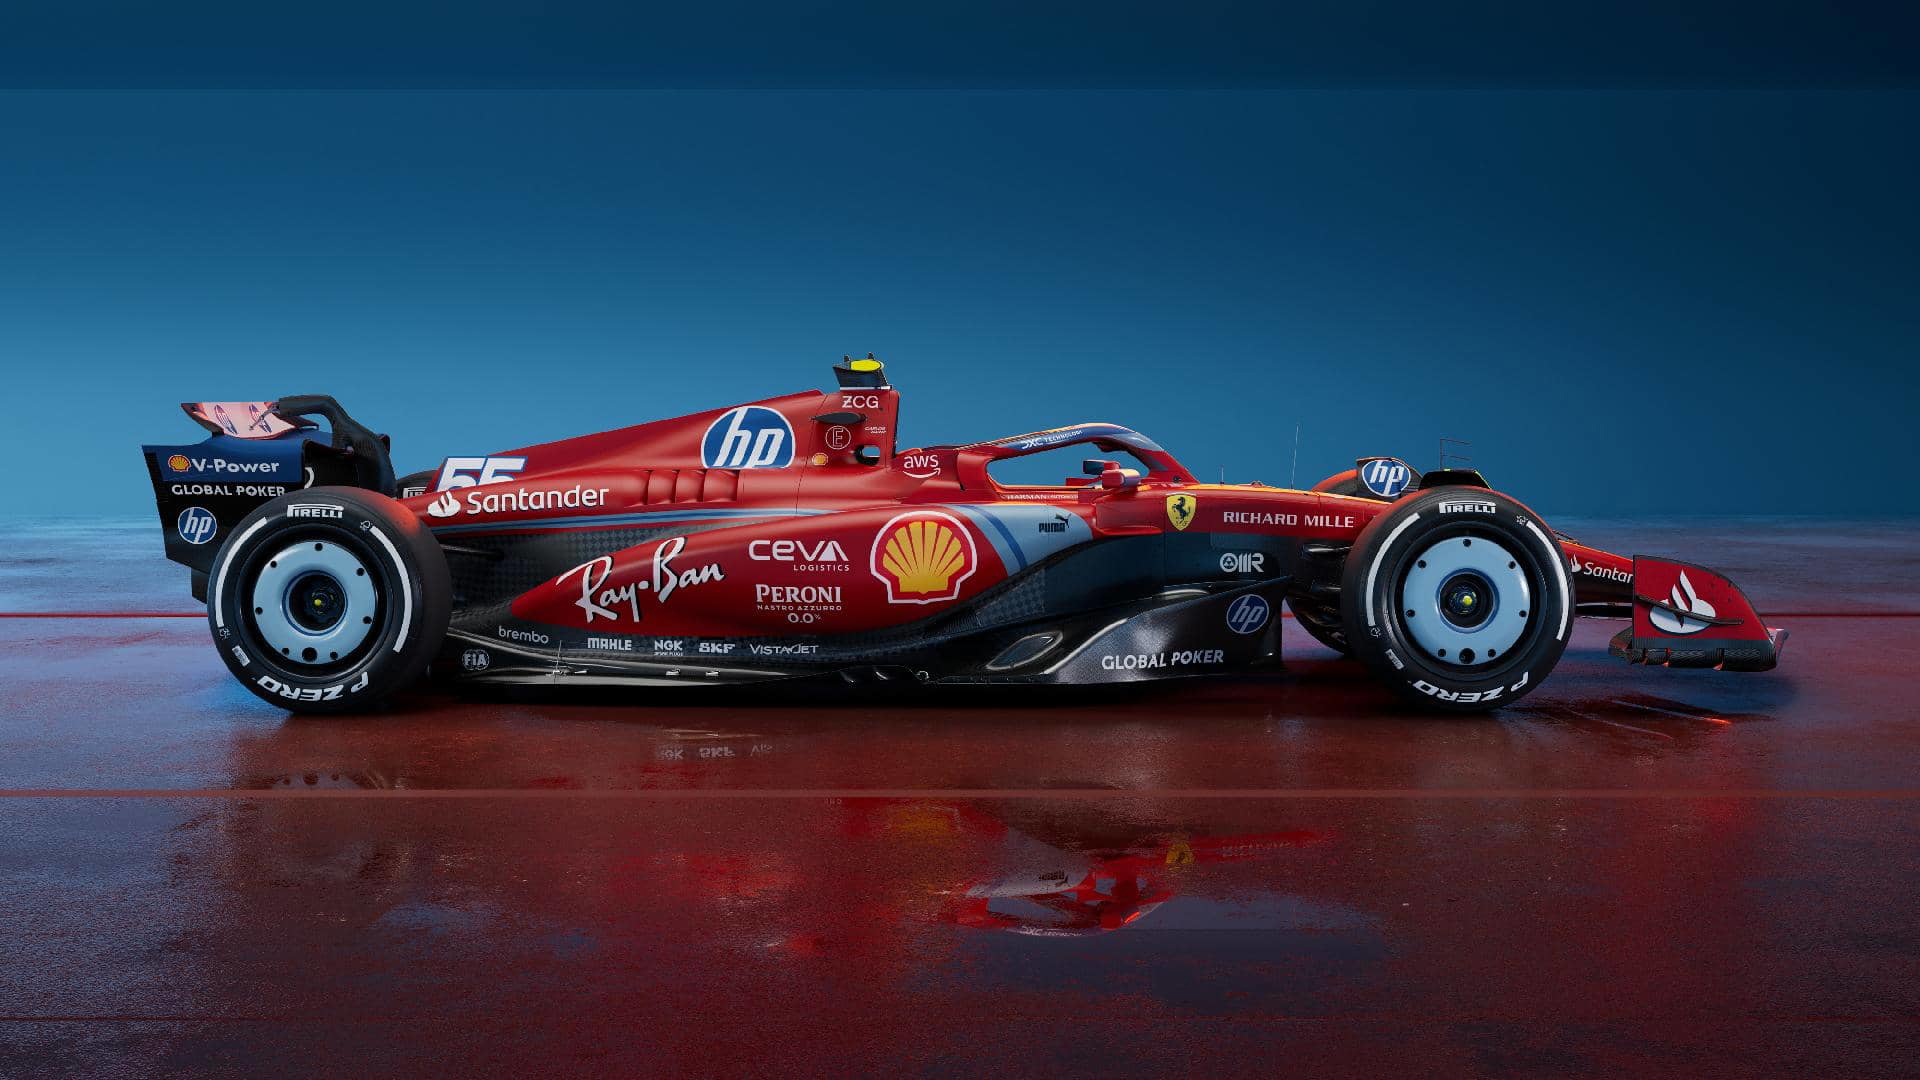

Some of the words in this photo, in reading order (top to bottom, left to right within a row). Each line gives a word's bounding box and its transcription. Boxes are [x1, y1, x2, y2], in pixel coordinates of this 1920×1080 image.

[842, 395, 879, 409] ZCG
[711, 406, 787, 468] hp
[191, 458, 280, 473] V-Power
[903, 454, 939, 469] aws
[1368, 460, 1405, 496] hp
[171, 484, 234, 497] GLOBAL
[235, 485, 286, 498] POKER
[466, 484, 610, 516] Santander
[286, 503, 345, 519] PIRELLI
[1438, 500, 1497, 515] PIRELLI
[182, 508, 213, 544] hp
[1038, 522, 1066, 533] PUMA
[1223, 511, 1298, 527] RICHARD
[1304, 515, 1355, 529] MILLE
[793, 564, 850, 573] LOGISTICS
[755, 583, 842, 604] PERONI
[1229, 594, 1266, 634] hp
[498, 625, 550, 645] brembo
[587, 637, 633, 651] MAHLE
[654, 639, 683, 651] NGK
[698, 641, 736, 654] SKF
[463, 653, 488, 667] FIA
[1101, 651, 1167, 670] GLOBAL
[1170, 649, 1225, 666] POKER
[256, 675, 345, 702] ZERO
[350, 671, 370, 694] P
[1412, 679, 1506, 703] ZERO
[1510, 671, 1530, 693] P
